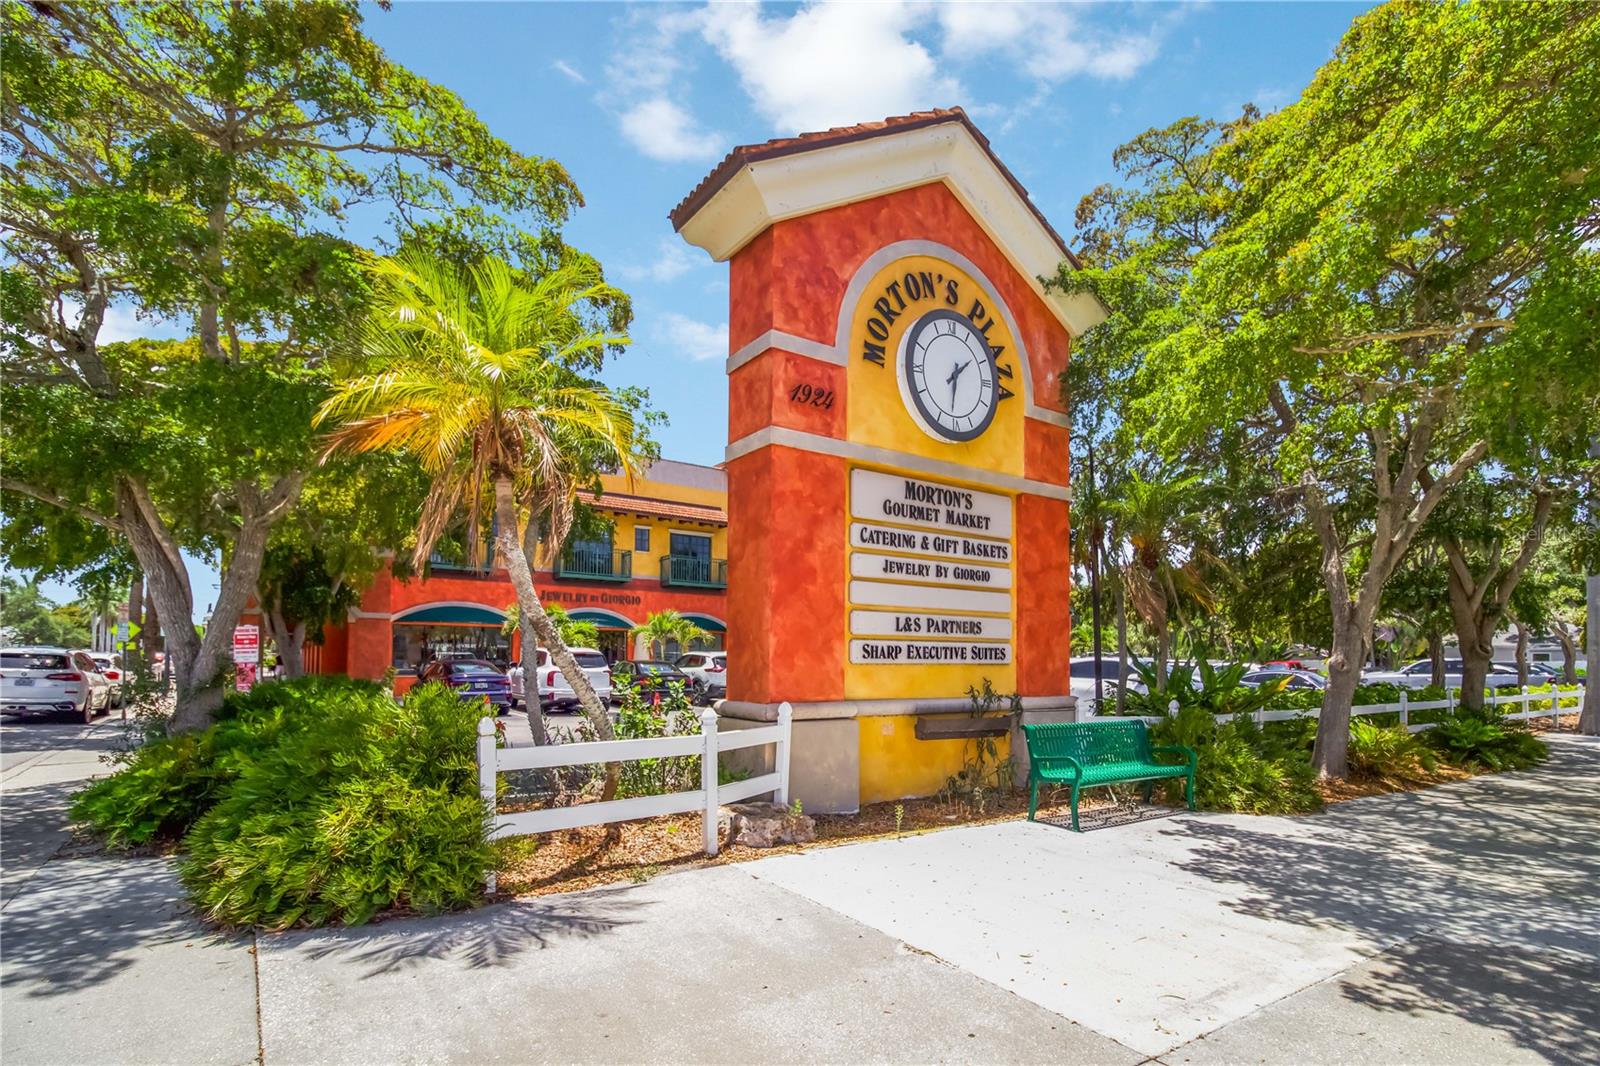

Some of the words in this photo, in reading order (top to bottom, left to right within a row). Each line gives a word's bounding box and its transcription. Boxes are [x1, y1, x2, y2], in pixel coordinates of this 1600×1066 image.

[863, 271, 959, 368] MORTON'S
[967, 299, 1015, 401] PLAZA
[791, 384, 834, 410] 1924
[904, 481, 973, 510] MORTON'S
[883, 500, 940, 522] GOURMET
[945, 511, 990, 530] MARKET
[860, 527, 916, 549] CATERING
[921, 536, 929, 551] &
[933, 536, 959, 554] GIFT
[963, 540, 1008, 560] BASKETS
[882, 559, 931, 577] JEWELRY
[935, 565, 949, 579] BY
[953, 566, 991, 582] GIORGIO
[541, 590, 588, 603] JEWELRY
[601, 592, 641, 605] GIORGIO
[895, 616, 921, 633] L&S
[926, 618, 982, 635] PARTNERS
[862, 643, 902, 661] SHARP
[907, 644, 967, 661] EXECUTIVE
[971, 646, 1006, 661] SUITES
